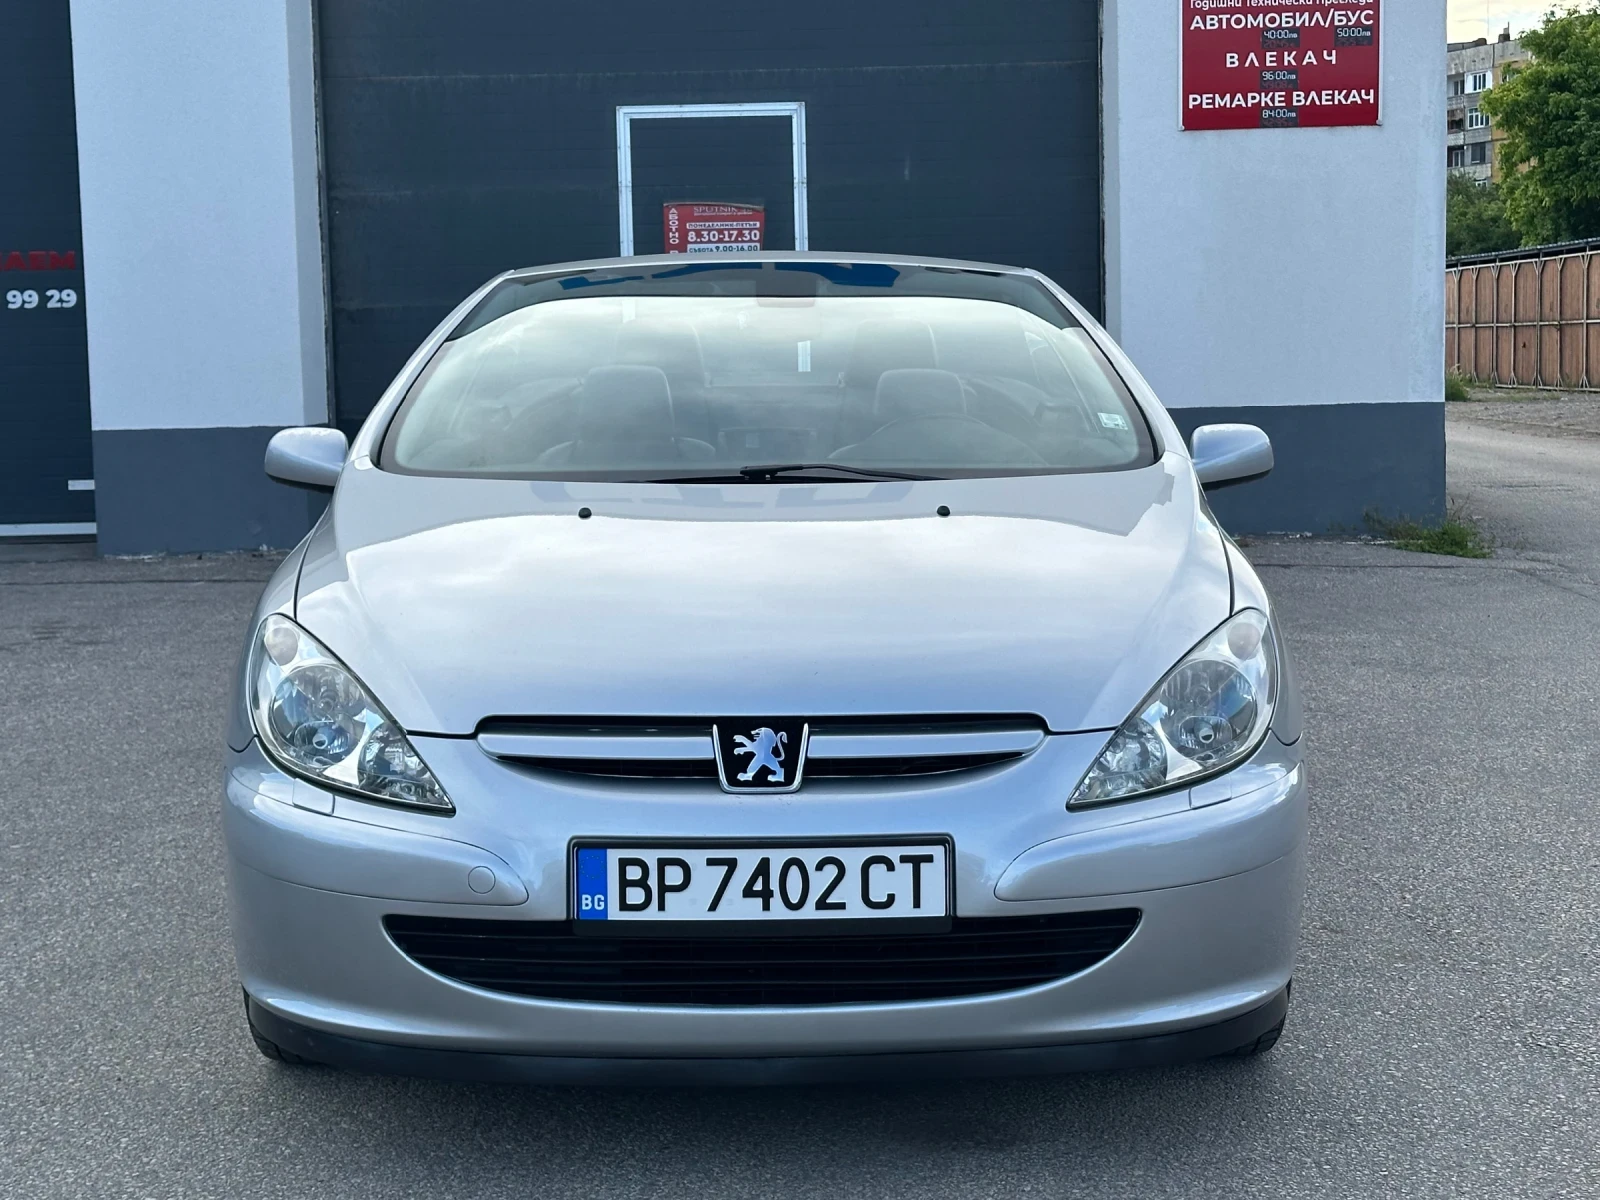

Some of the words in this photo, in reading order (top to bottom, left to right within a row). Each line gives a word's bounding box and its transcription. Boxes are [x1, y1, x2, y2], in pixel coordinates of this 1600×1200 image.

[1190, 8, 1374, 30] АВТОМОБИЛ/БУС
[1226, 50, 1337, 68] ВЛЕКАЧ
[1188, 91, 1286, 109] РЕМАРКЕ
[1292, 89, 1375, 107] ВЛЕКАЧ
[668, 206, 679, 244] АБОТНО
[687, 230, 760, 242] 8.30-17.30
[6, 290, 39, 309] 99
[45, 289, 77, 308] 29
[581, 894, 605, 911] BG
[706, 856, 847, 912] 7402
